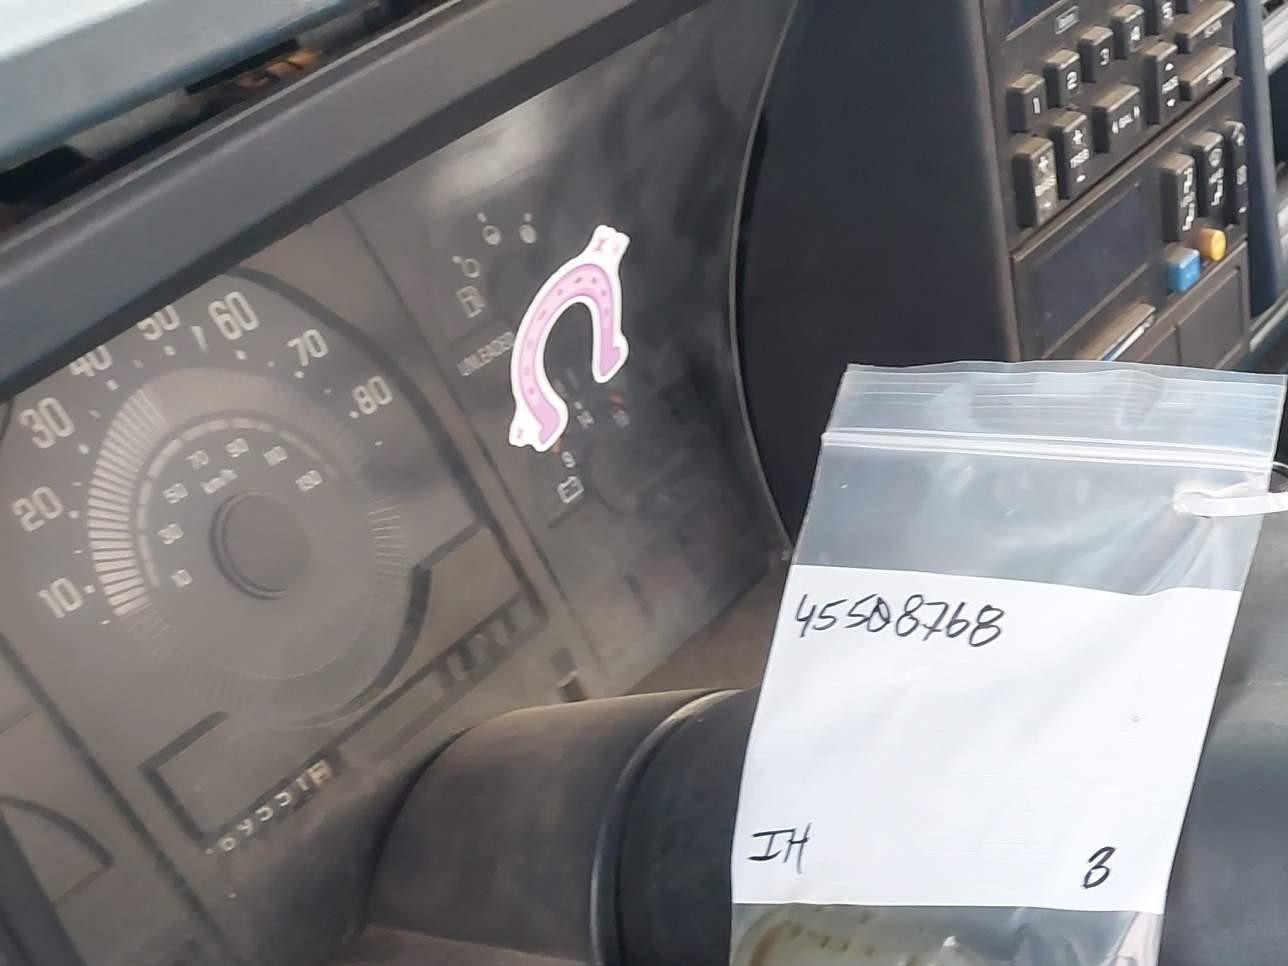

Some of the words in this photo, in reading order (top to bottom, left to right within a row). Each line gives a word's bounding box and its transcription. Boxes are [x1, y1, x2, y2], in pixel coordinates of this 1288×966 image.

[1131, 26, 1140, 40] 4
[1100, 48, 1110, 66] 3
[1066, 71, 1078, 90] 2
[1033, 97, 1041, 114] 1
[208, 291, 259, 341] 60
[287, 329, 329, 367] 70
[352, 376, 393, 416] 80
[19, 397, 75, 449] 30
[13, 486, 63, 532] 20
[38, 578, 83, 618] 10
[794, 593, 1004, 648] 45508768
[748, 822, 812, 874] IH
